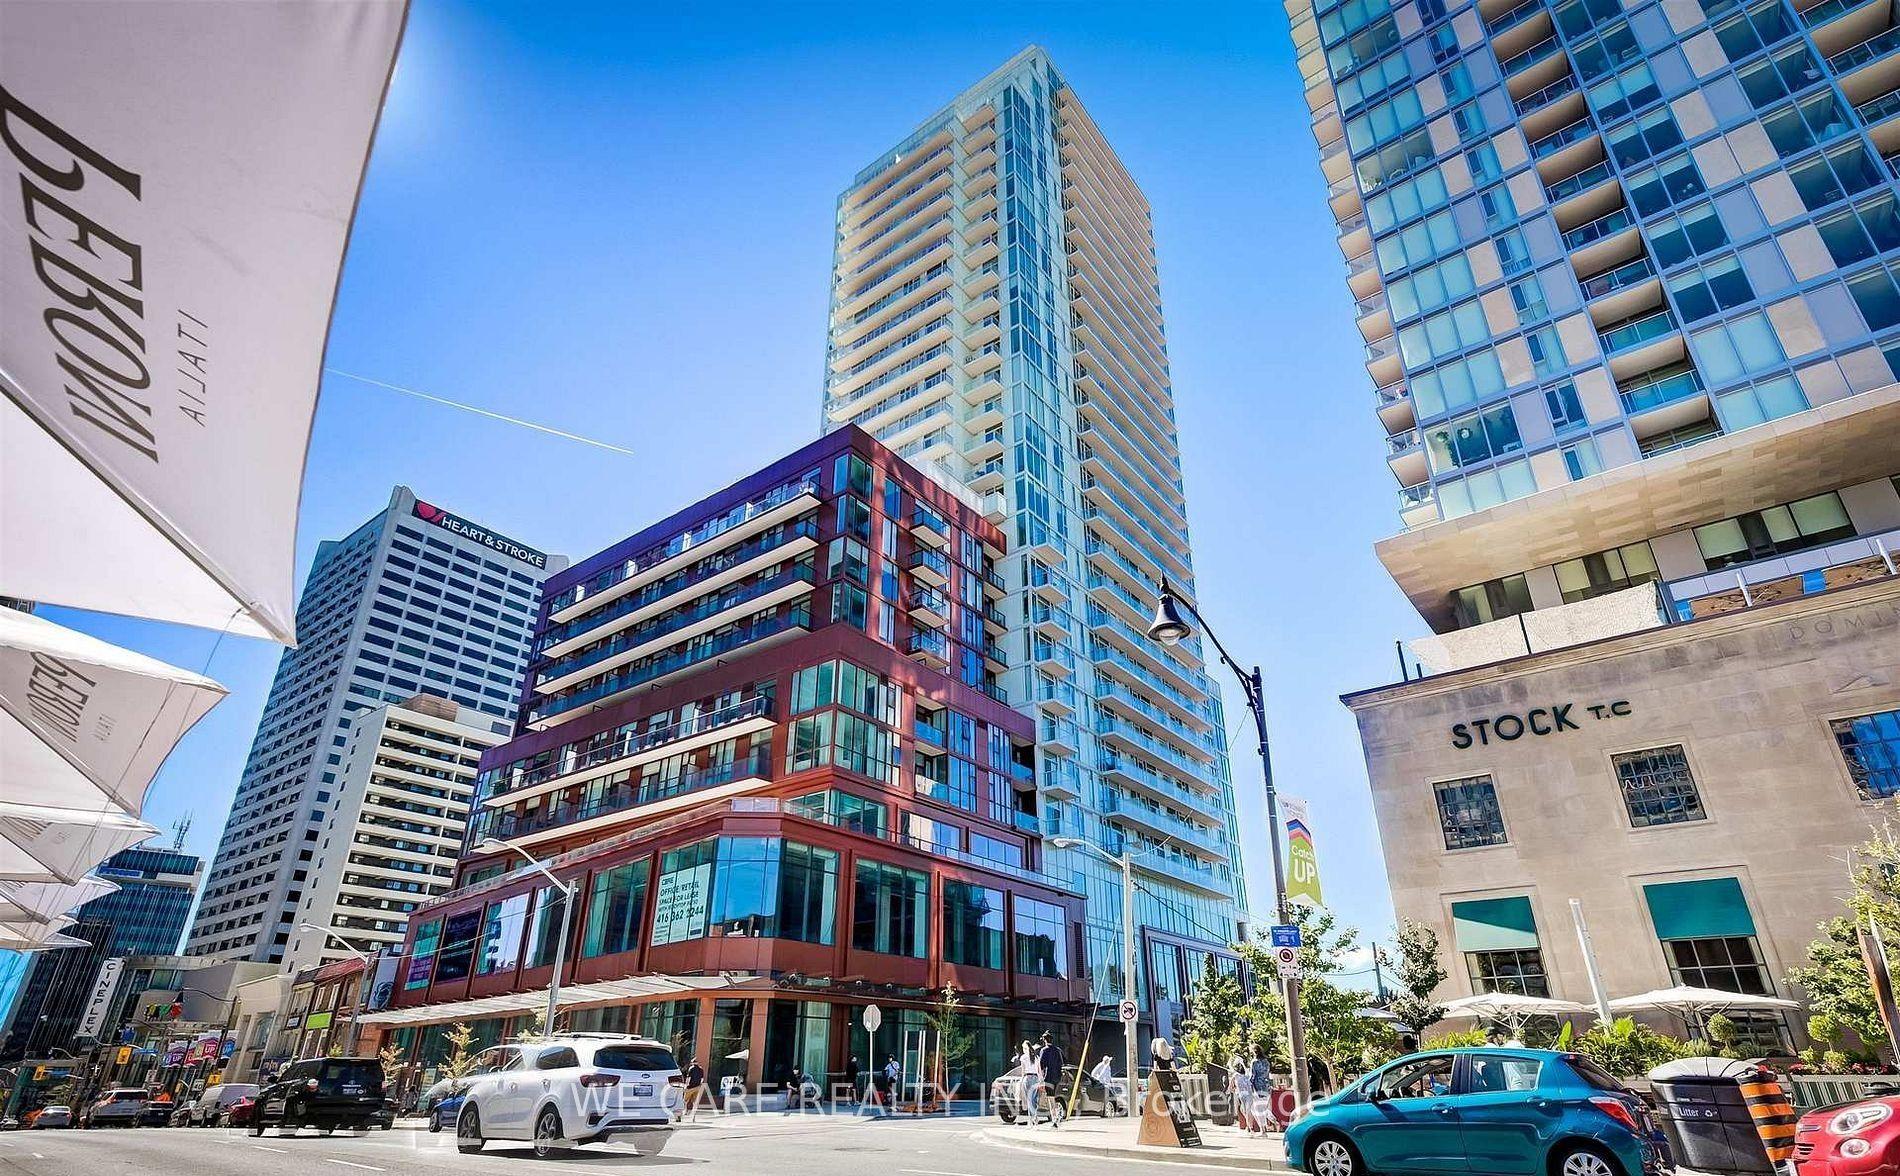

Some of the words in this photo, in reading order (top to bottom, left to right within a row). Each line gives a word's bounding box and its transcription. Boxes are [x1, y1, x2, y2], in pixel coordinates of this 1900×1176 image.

[442, 516, 486, 542] HEART
[495, 539, 545, 567] STROKE
[1452, 703, 1580, 749] STOCK
[1294, 859, 1315, 885] UP
[657, 913, 670, 923] 416
[84, 962, 117, 1034] CINEPLEX
[1678, 1106, 1698, 1117] Litter
